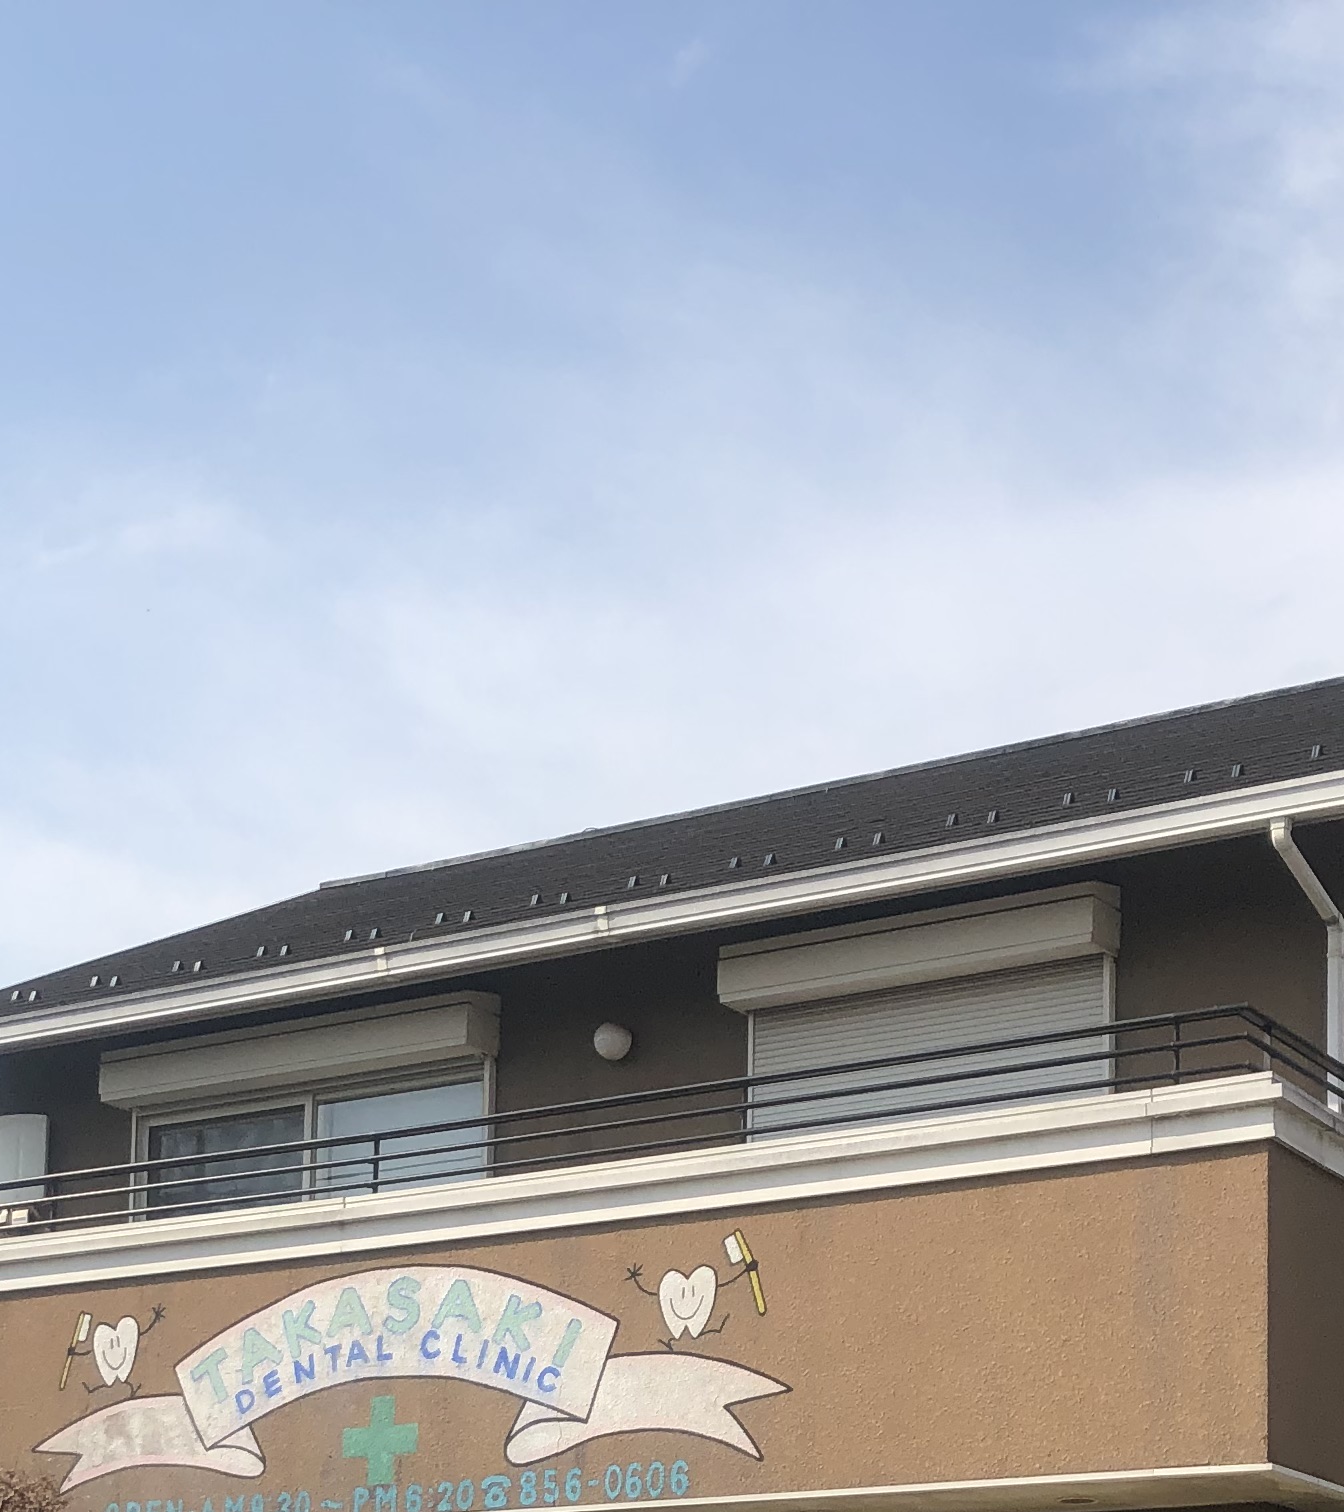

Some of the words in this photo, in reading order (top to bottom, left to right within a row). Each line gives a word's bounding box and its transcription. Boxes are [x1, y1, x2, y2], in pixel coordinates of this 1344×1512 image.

[189, 1275, 583, 1402] TAKASAKI
[234, 1334, 394, 1415] DENTAL
[419, 1328, 563, 1394] CLINIC
